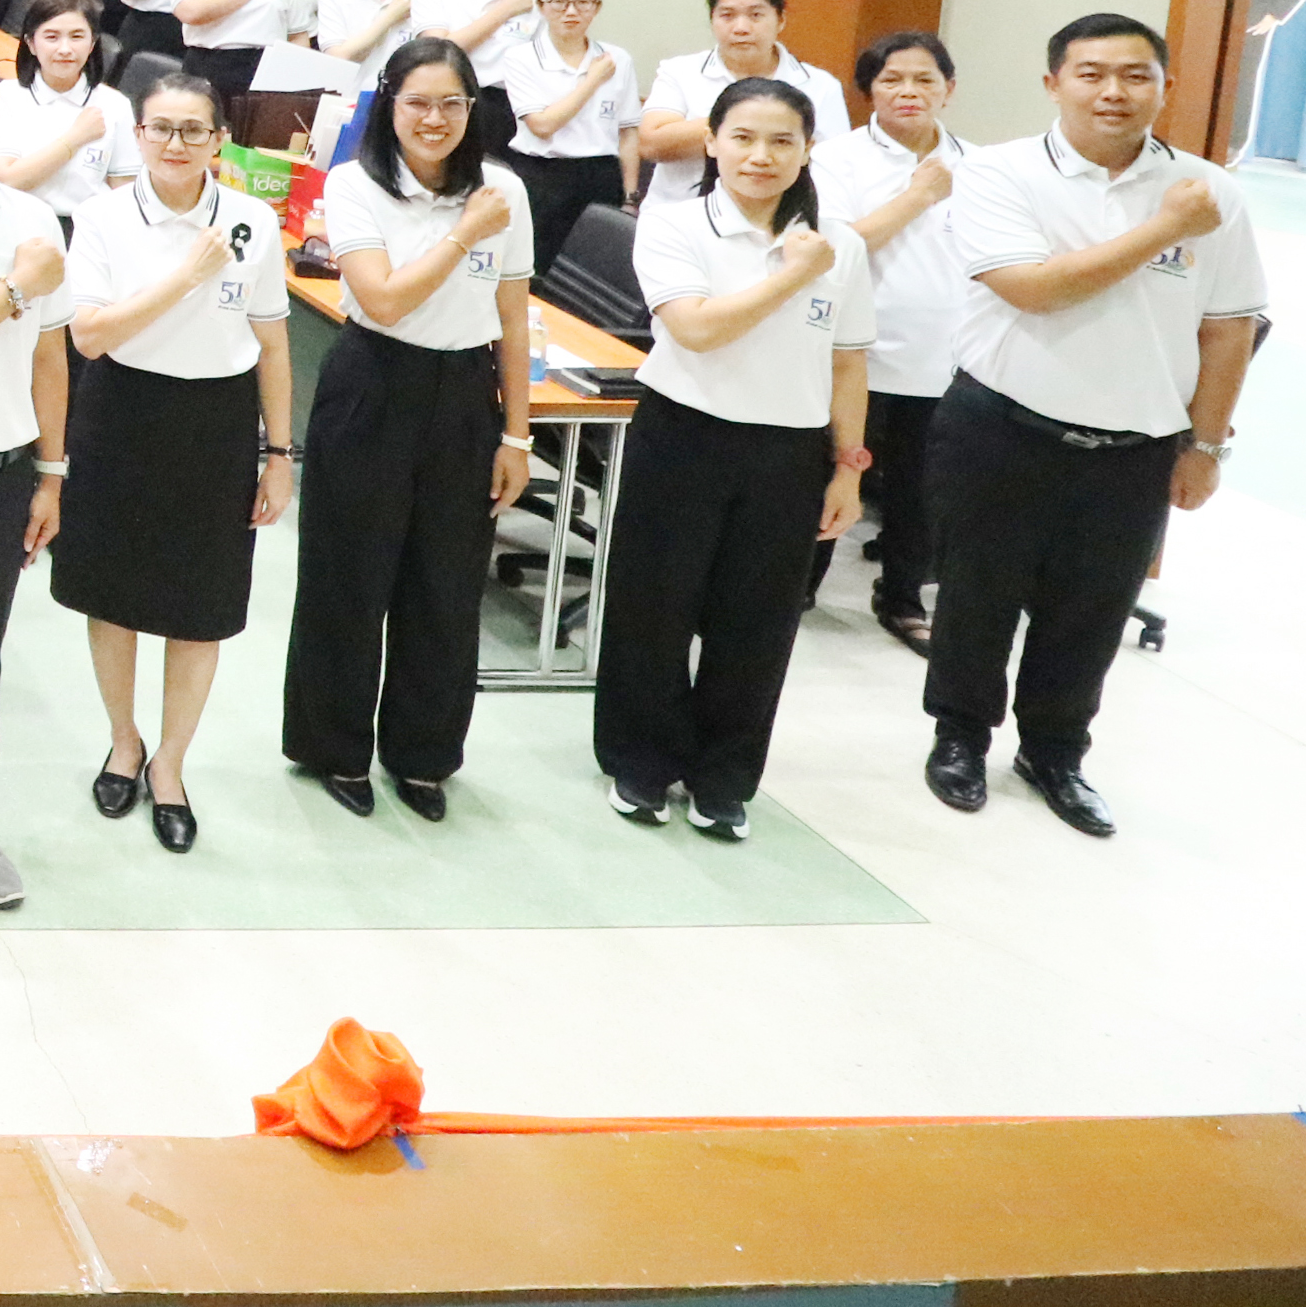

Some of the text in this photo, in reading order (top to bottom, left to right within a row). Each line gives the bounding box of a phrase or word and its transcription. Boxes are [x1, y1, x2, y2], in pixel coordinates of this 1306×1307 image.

[84, 147, 103, 164] 51
[468, 251, 493, 273] 51
[219, 281, 243, 304] 51
[807, 298, 832, 321] 51
